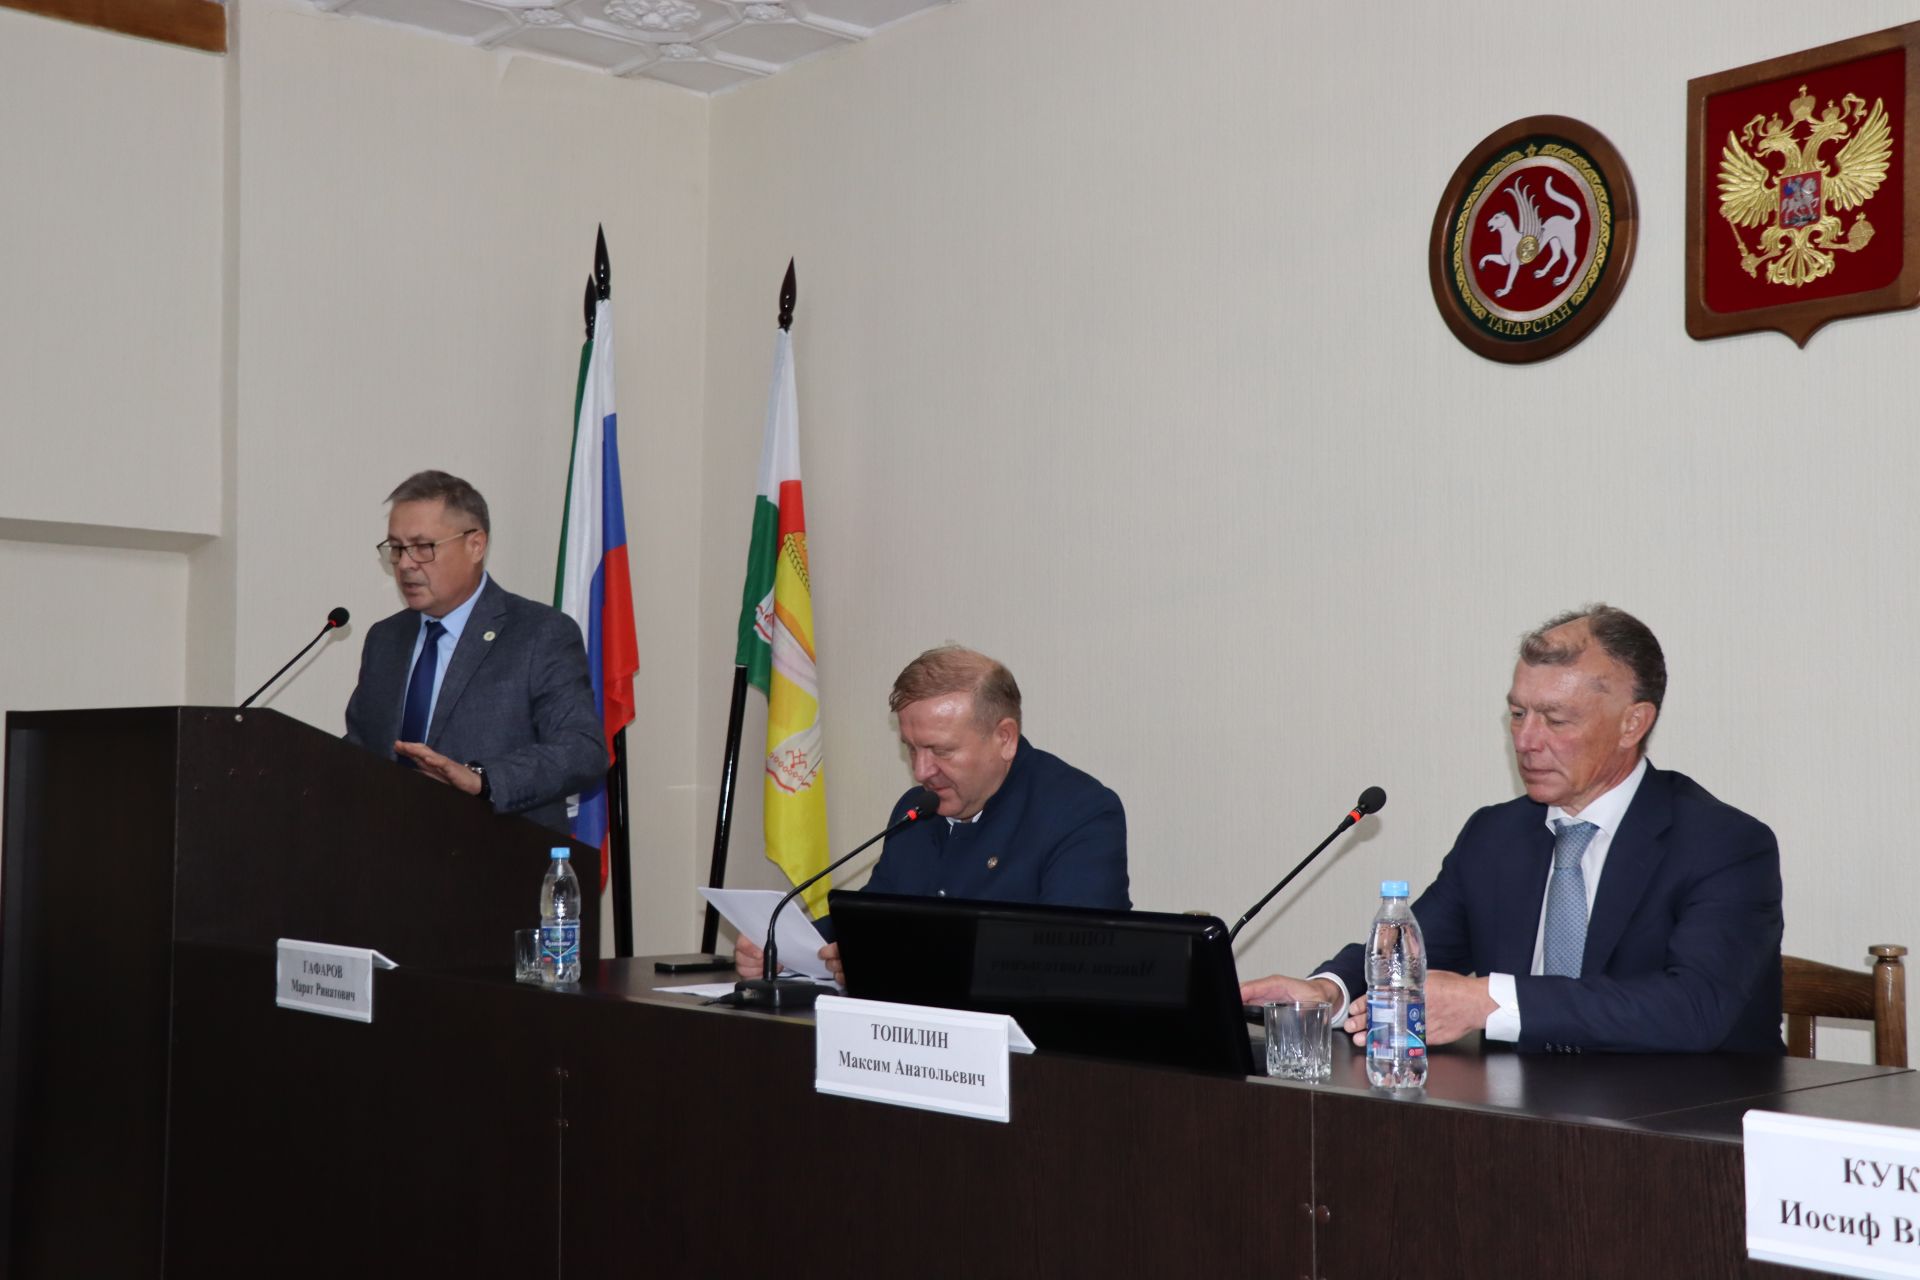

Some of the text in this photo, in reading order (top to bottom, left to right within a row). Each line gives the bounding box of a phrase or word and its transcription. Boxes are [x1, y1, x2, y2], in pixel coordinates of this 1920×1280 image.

[1488, 304, 1572, 335] ТАТАРСТАН
[303, 960, 343, 979] ГАФАРОВ
[291, 979, 314, 997] Марат
[871, 1023, 949, 1049] ТОПИЛИН
[838, 1050, 986, 1087] Максим Анатольевич
[1843, 1157, 1920, 1193] КУК
[1779, 1199, 1920, 1247] Иосиф В
